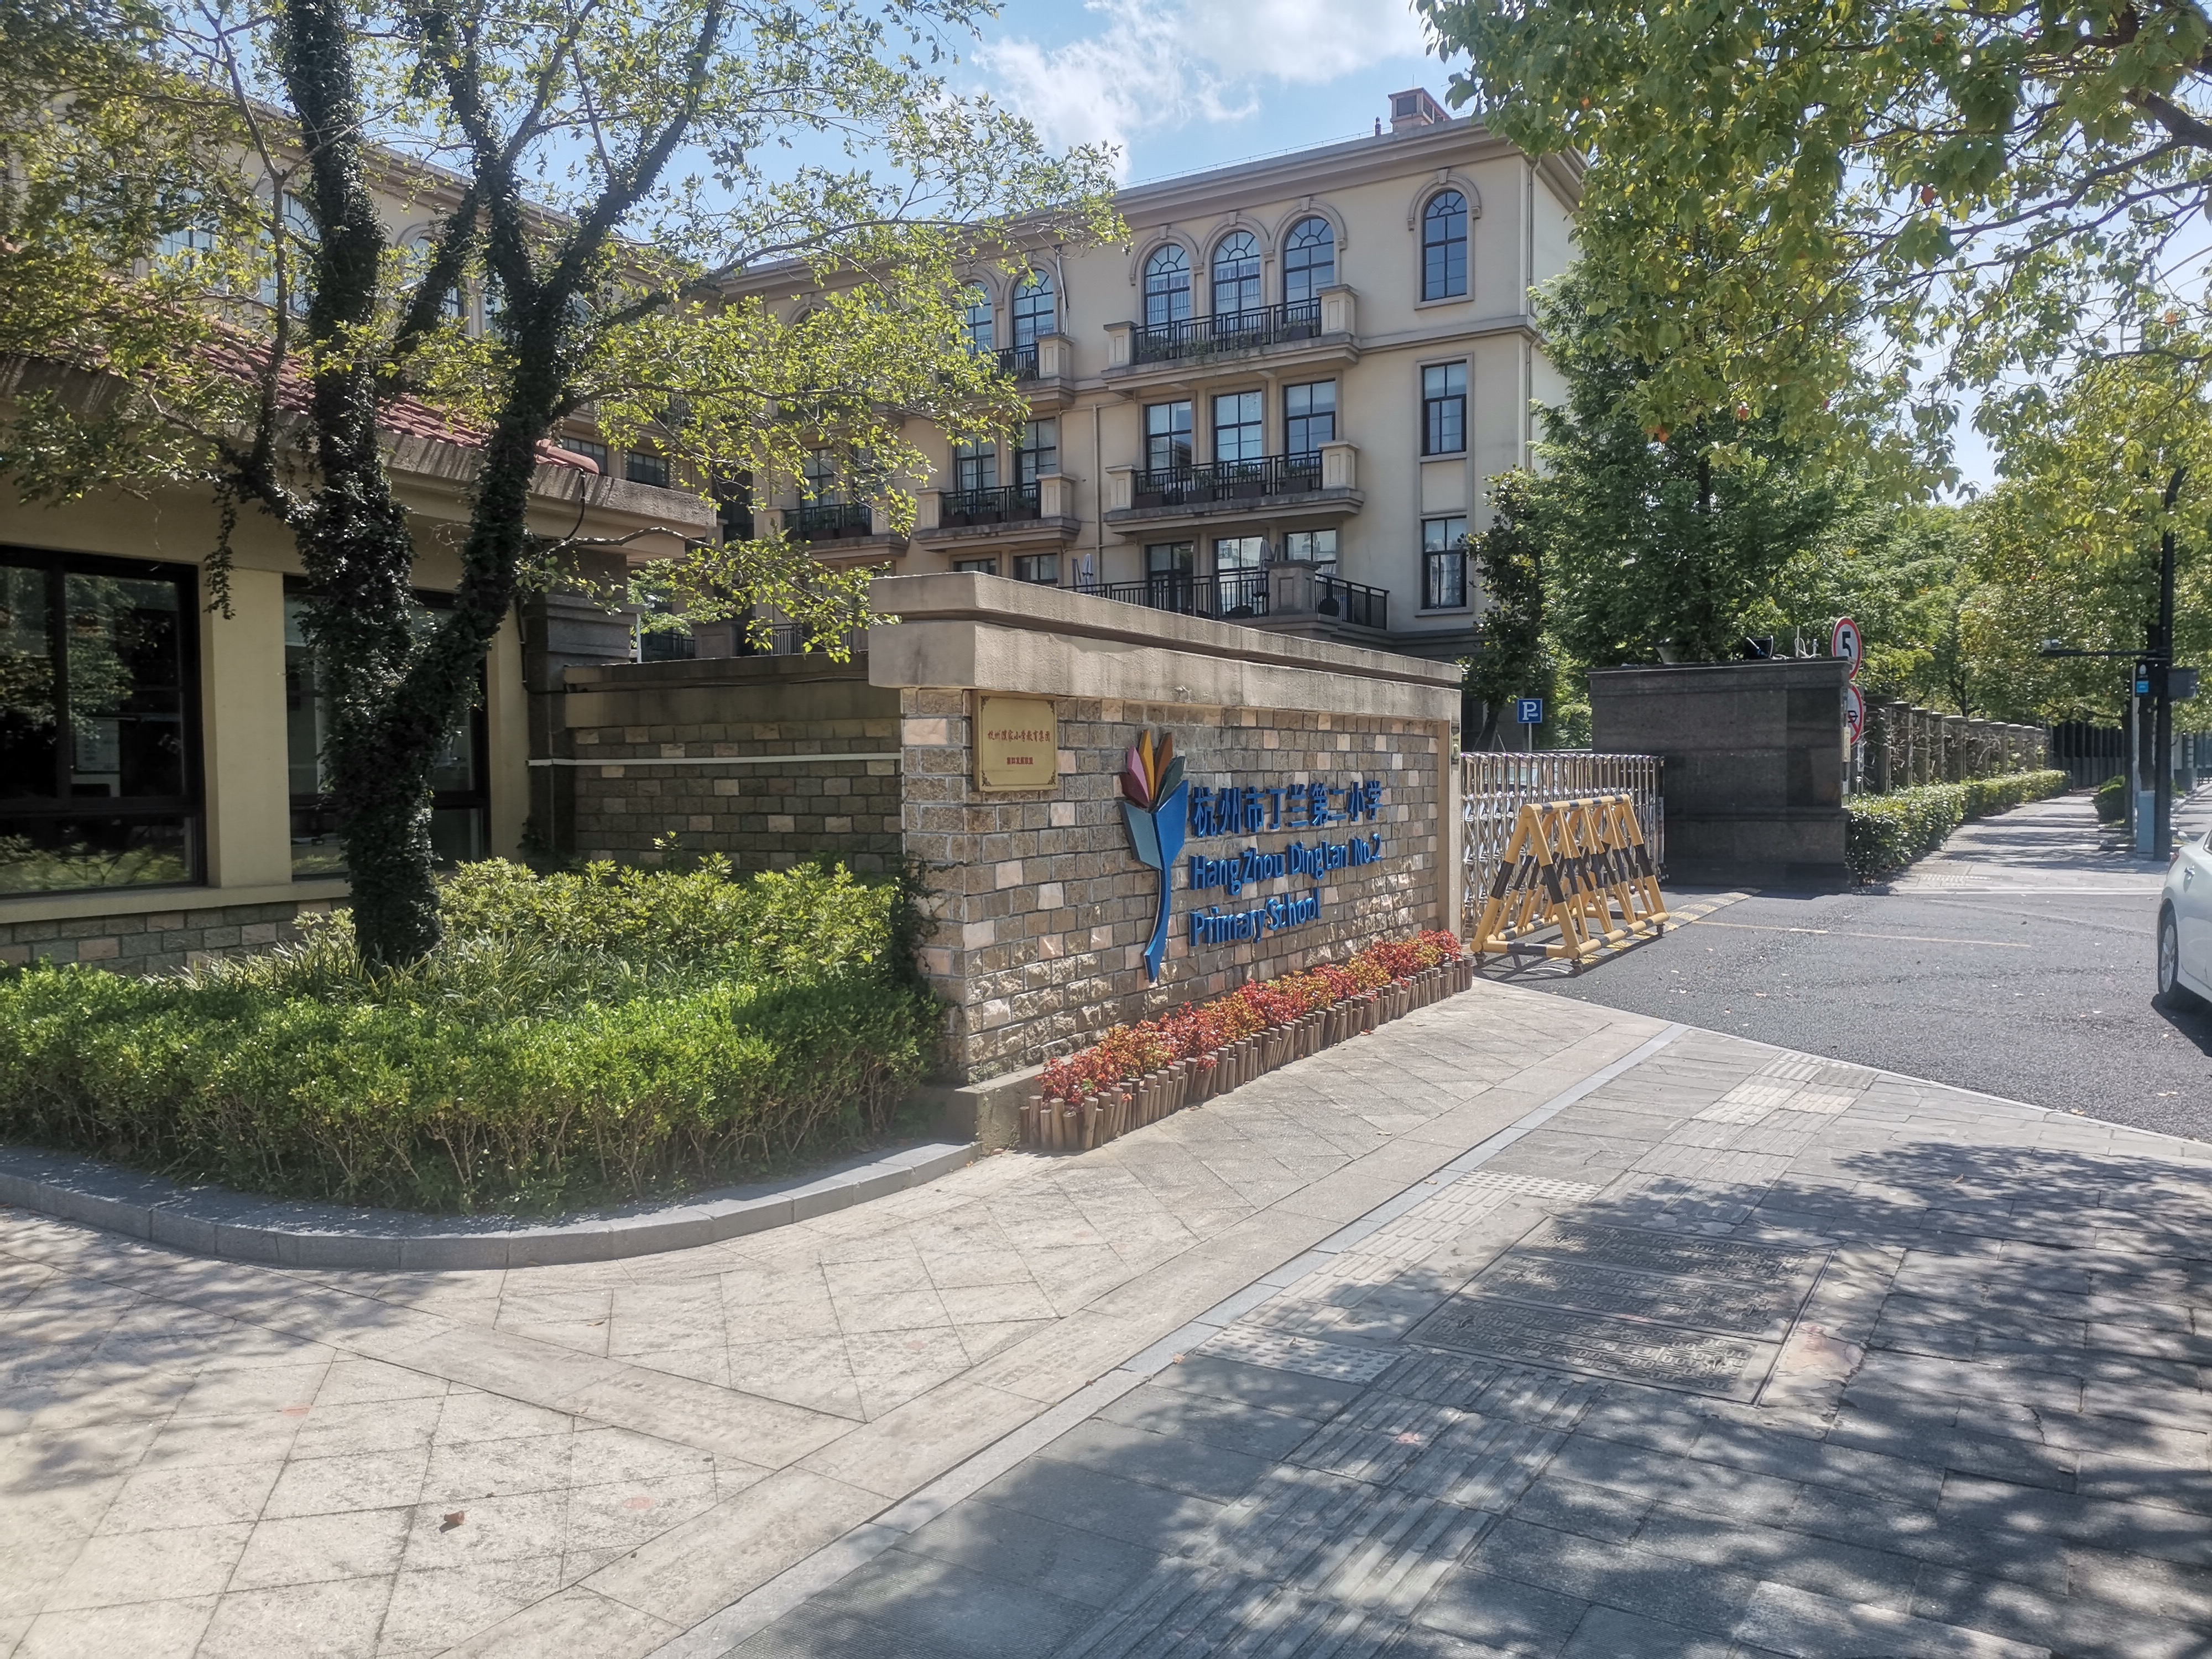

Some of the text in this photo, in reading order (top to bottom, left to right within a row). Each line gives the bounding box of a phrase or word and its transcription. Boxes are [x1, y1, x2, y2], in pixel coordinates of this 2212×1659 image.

[1522, 702, 1537, 720] P
[1192, 781, 1383, 838] 杭州市丁兰第二小学
[1190, 887, 1322, 947] Primary School
